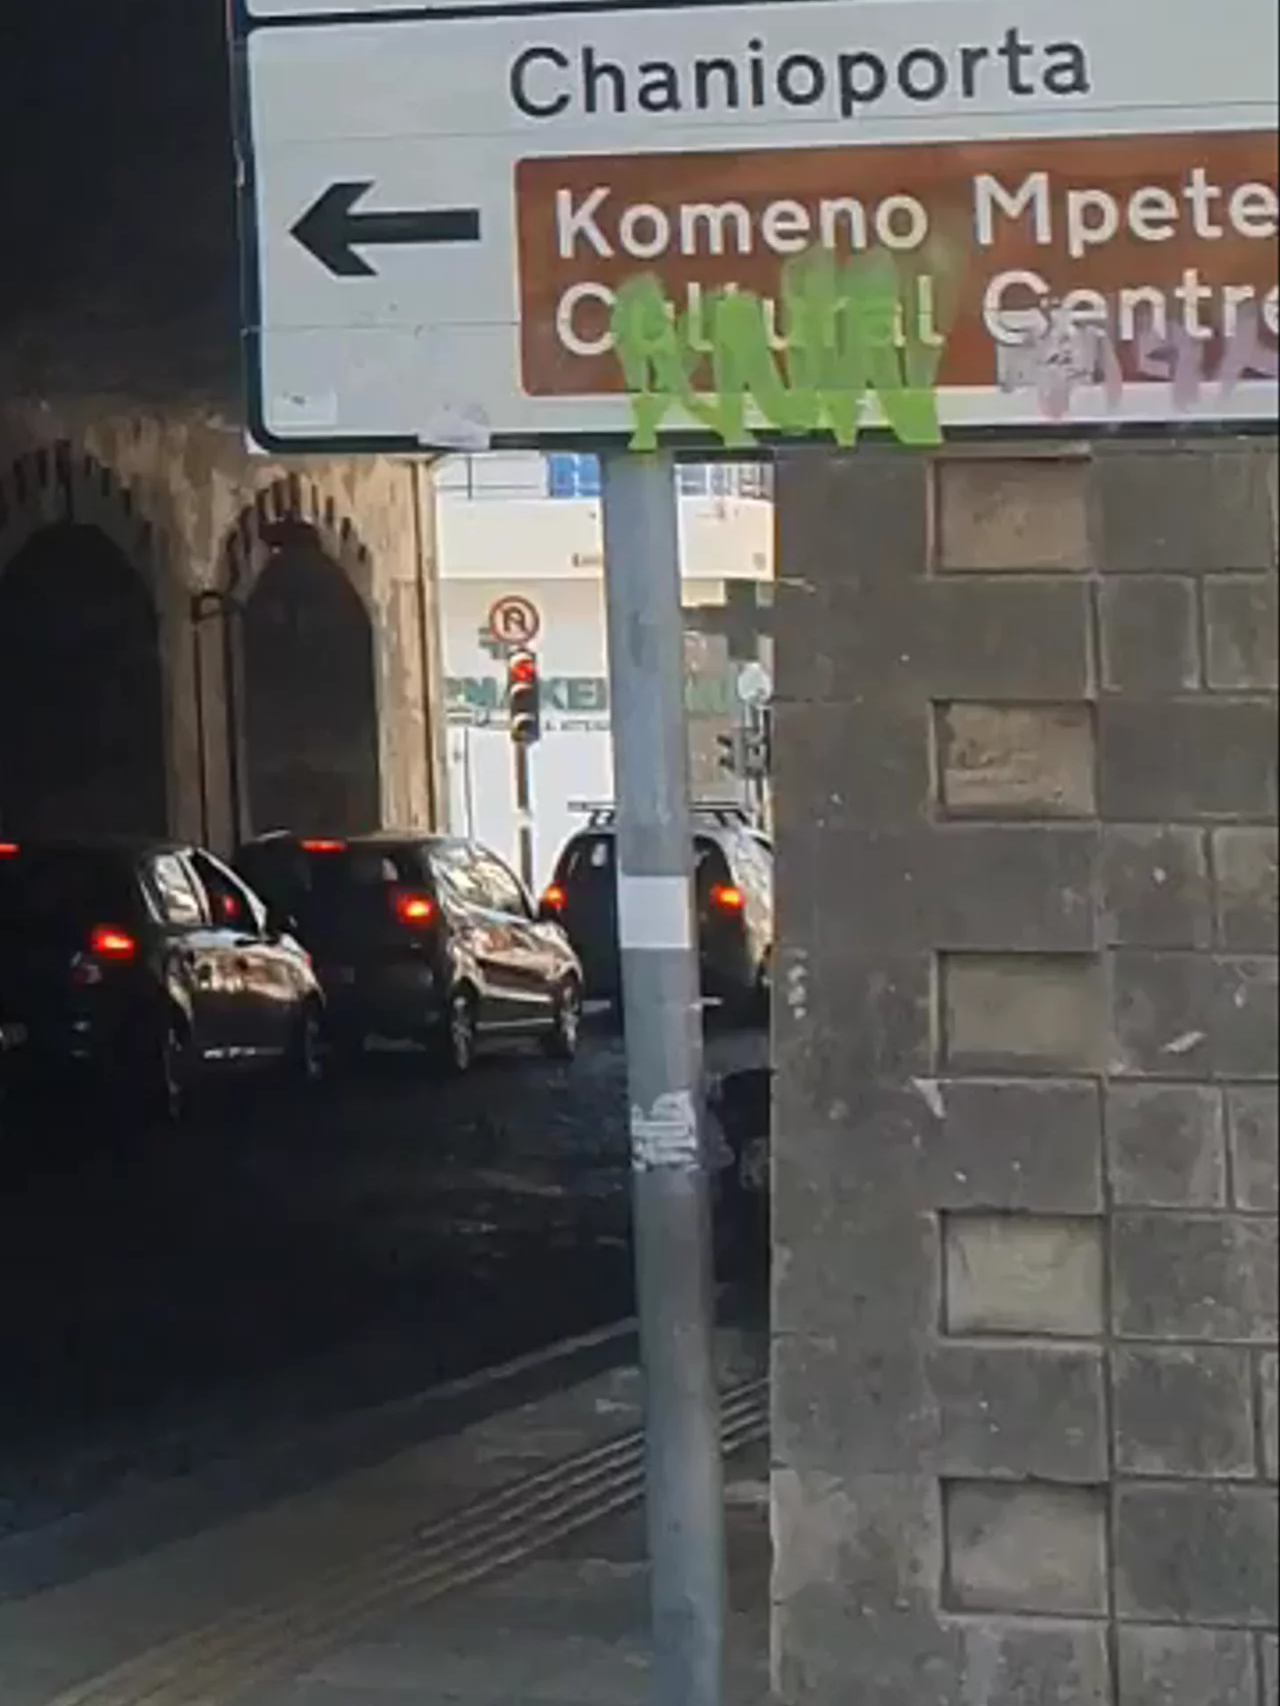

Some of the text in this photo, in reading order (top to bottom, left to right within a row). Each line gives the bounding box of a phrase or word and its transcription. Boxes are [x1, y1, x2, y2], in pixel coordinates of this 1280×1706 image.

[510, 27, 1091, 118] Chanioporta
[555, 168, 1280, 259] Komeno Mpete
